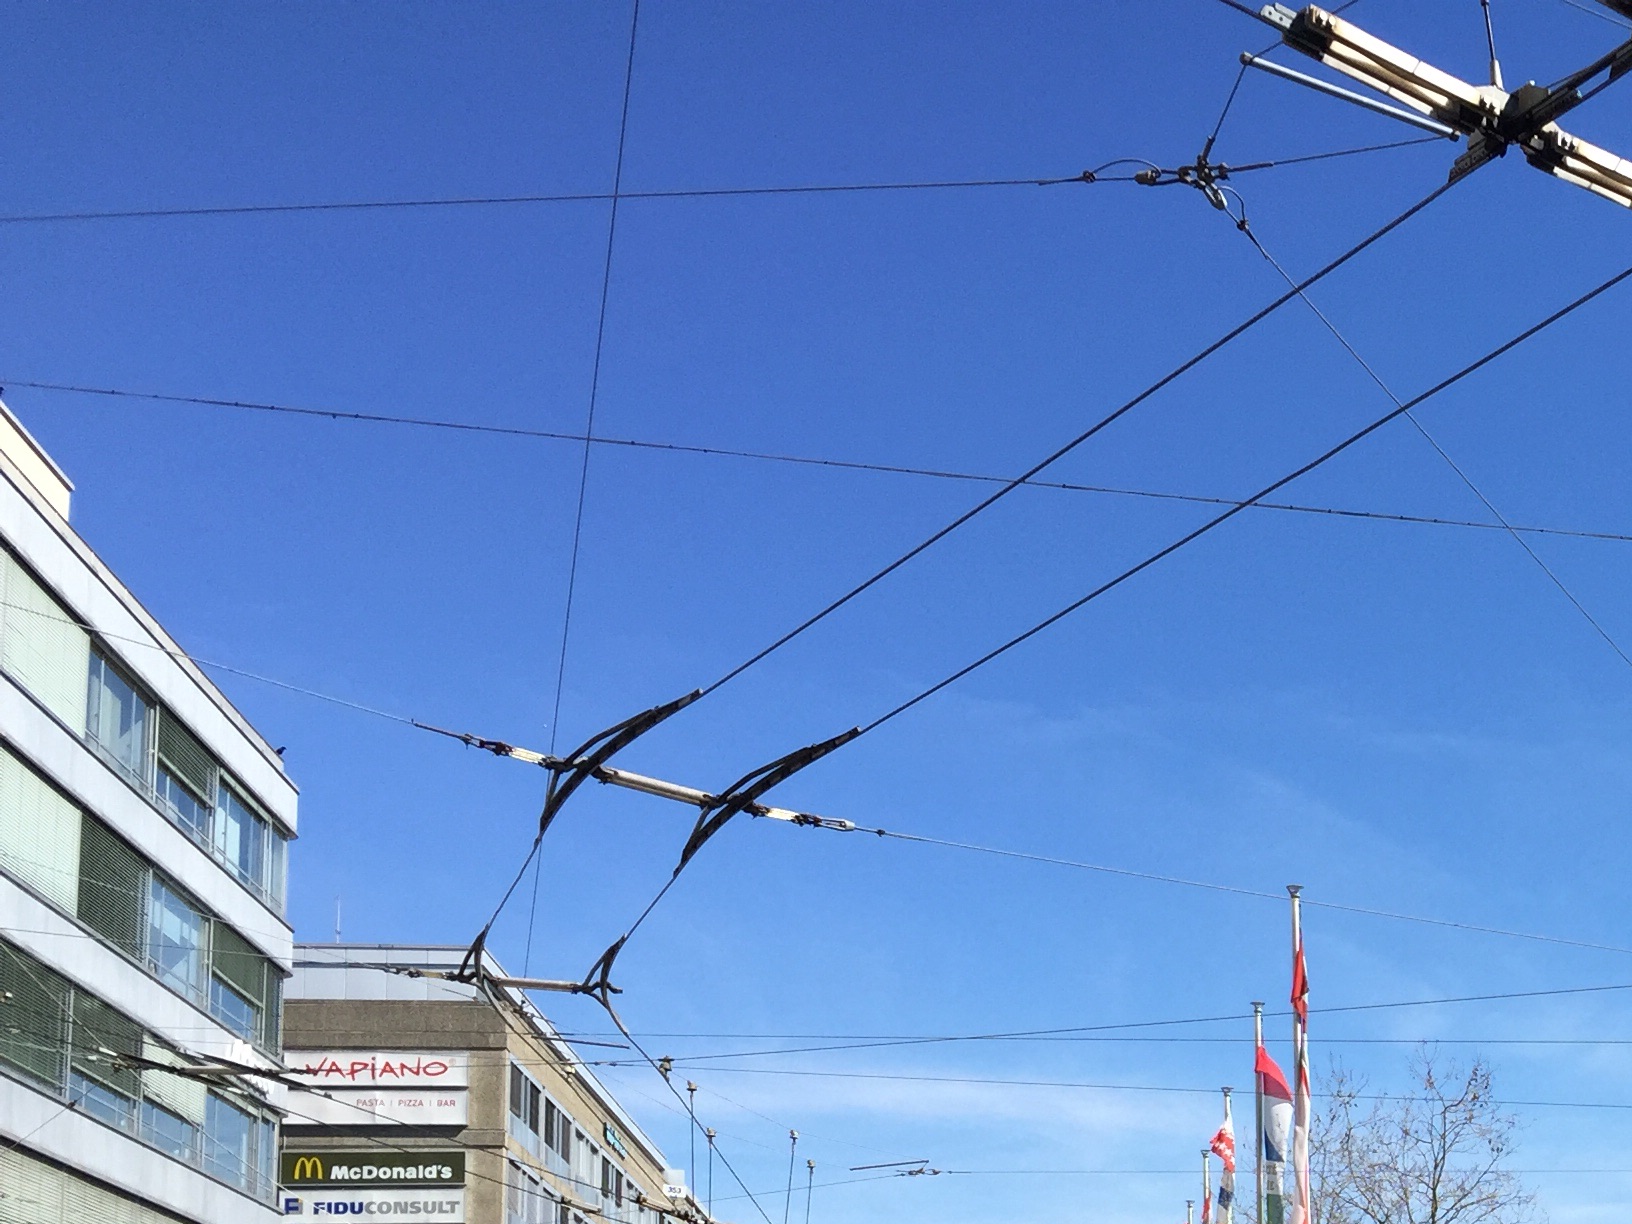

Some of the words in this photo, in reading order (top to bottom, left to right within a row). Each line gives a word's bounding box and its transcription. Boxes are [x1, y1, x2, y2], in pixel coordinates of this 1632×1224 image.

[356, 1099, 385, 1107] PASTA
[398, 1099, 424, 1107] PIZZA
[437, 1099, 456, 1107] BAR
[330, 1164, 453, 1180] McDonald's
[313, 1201, 460, 1215] FIDUCONSULT
